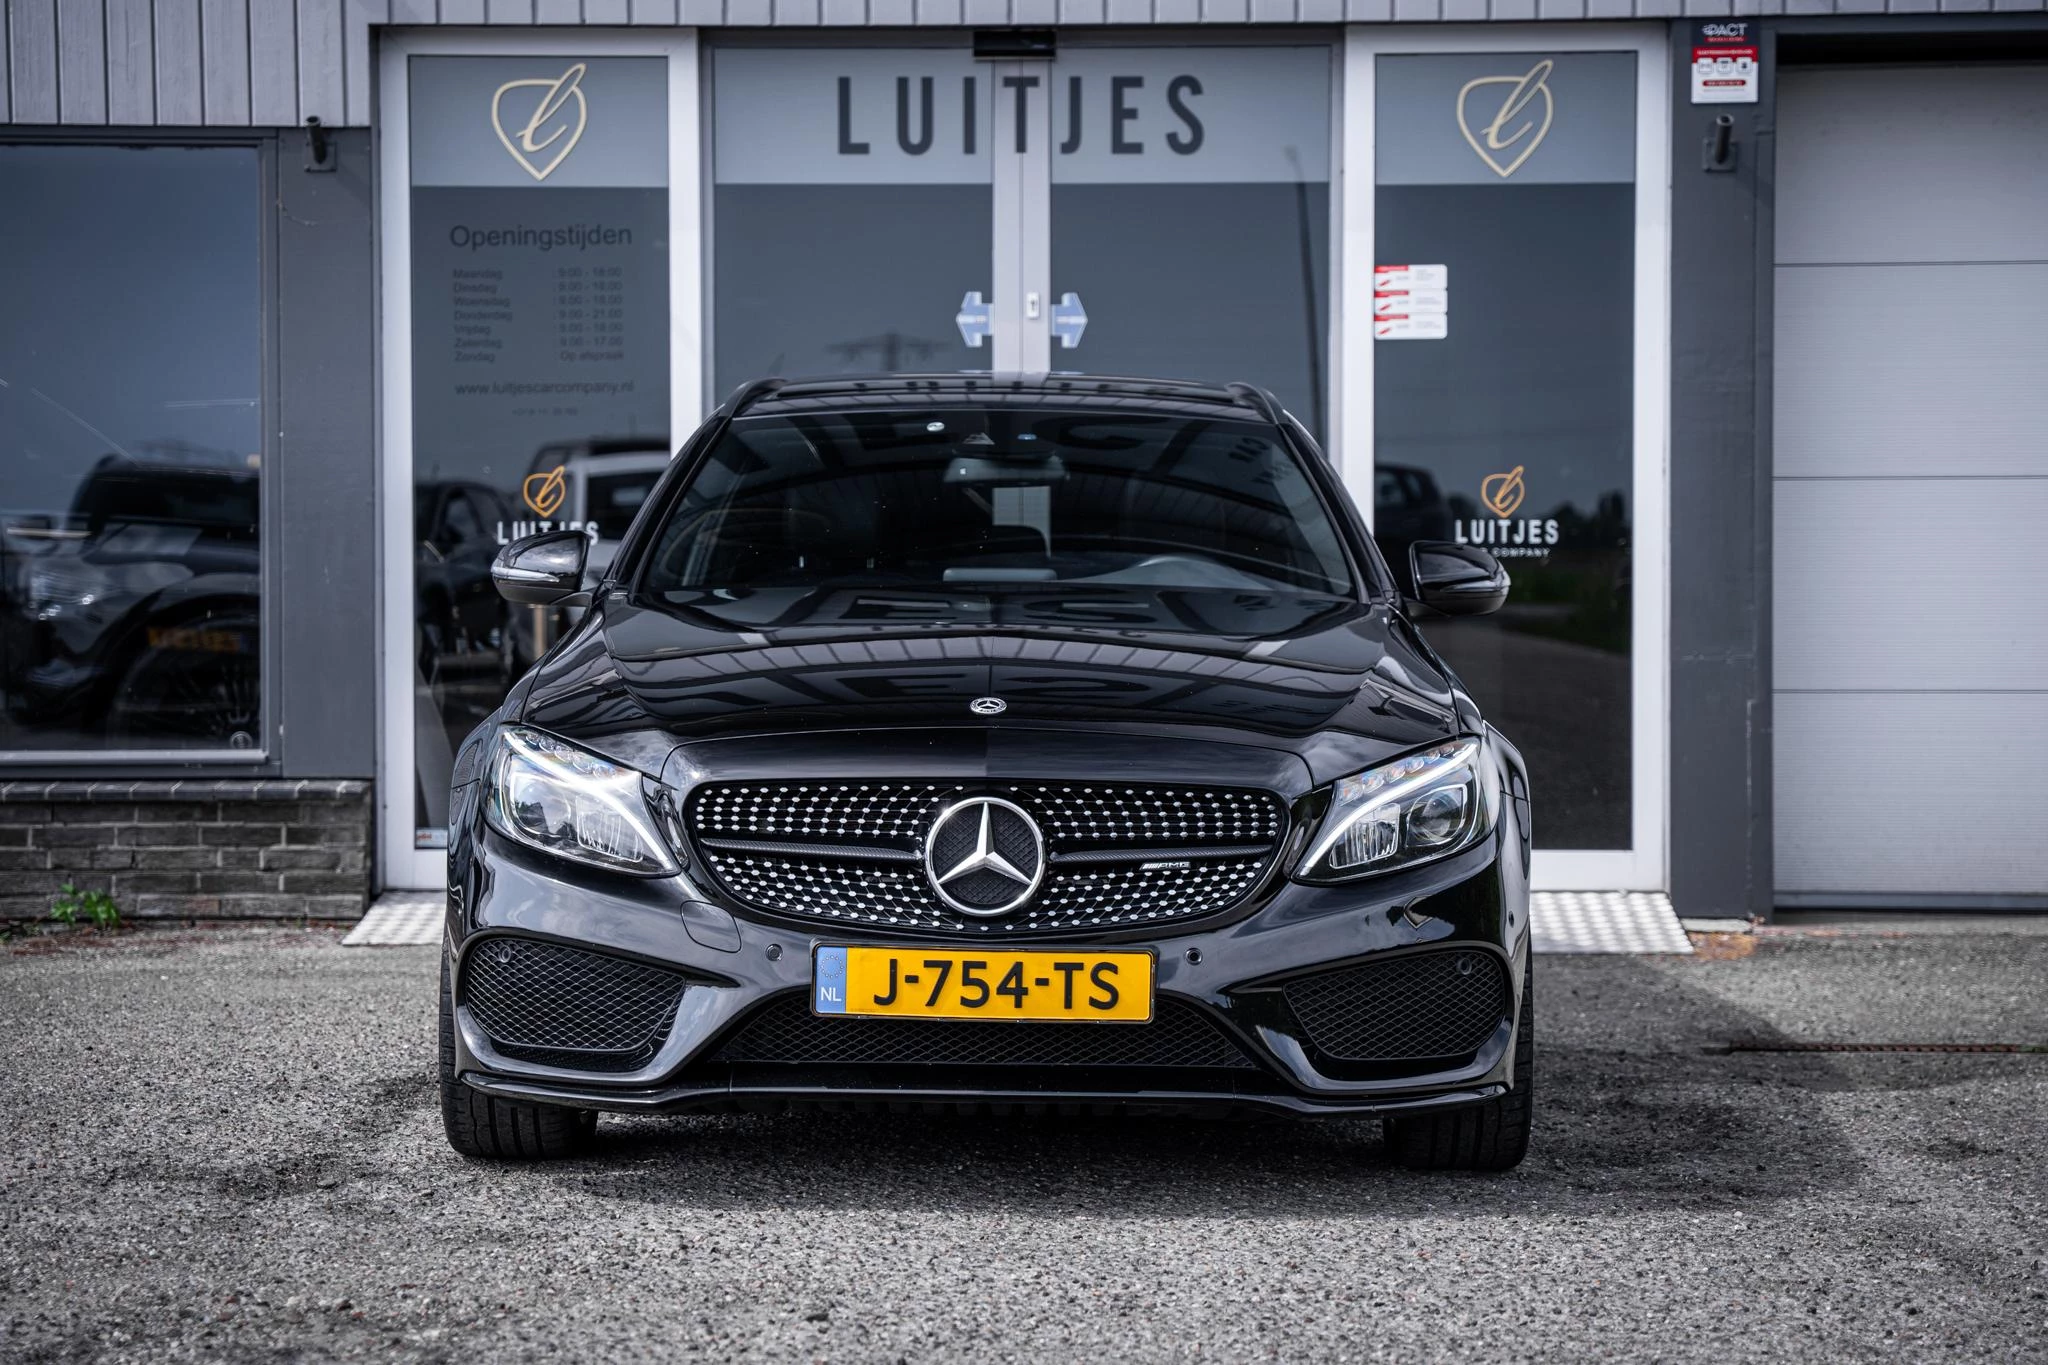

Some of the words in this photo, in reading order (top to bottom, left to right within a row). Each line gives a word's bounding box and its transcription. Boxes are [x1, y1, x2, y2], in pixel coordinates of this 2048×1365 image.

[837, 75, 1206, 156] LUITJES
[450, 224, 633, 251] Openingstijden
[1455, 519, 1559, 544] LUITJES
[1491, 547, 1551, 557] COMPANY
[821, 987, 842, 1002] NL
[873, 958, 1120, 1011] J-754-TS
